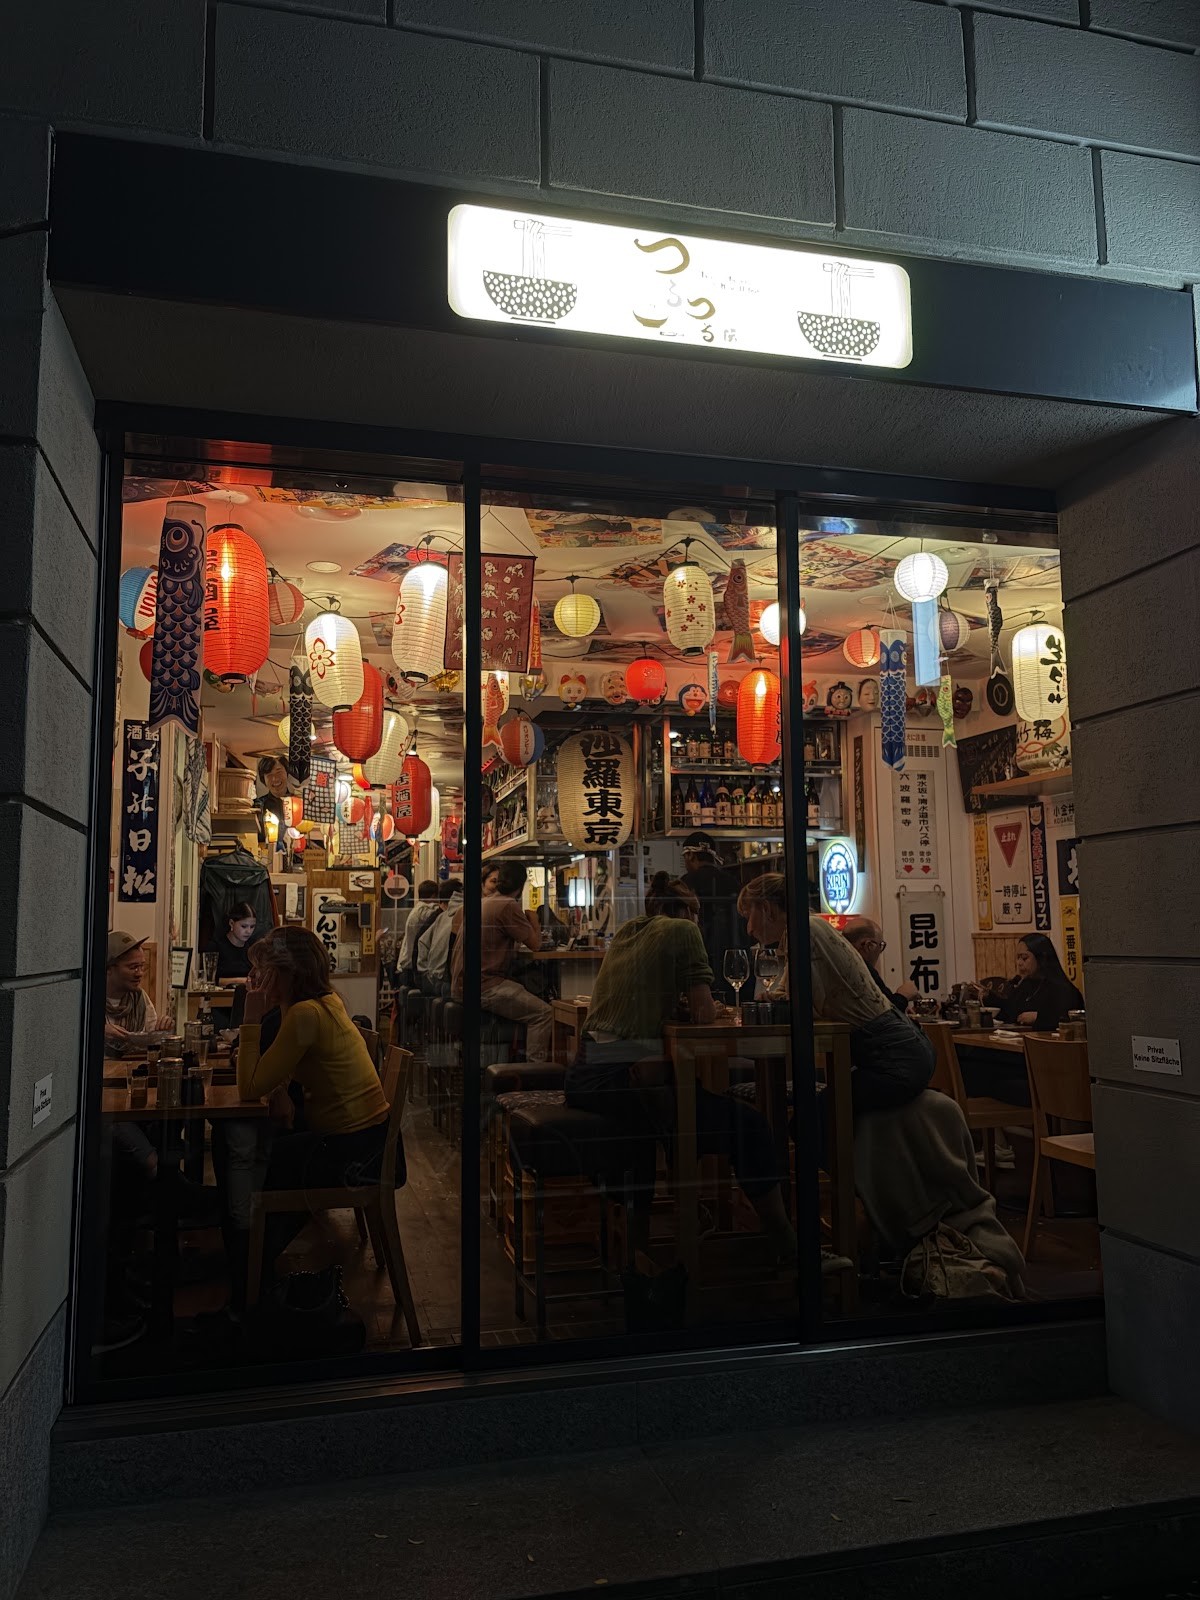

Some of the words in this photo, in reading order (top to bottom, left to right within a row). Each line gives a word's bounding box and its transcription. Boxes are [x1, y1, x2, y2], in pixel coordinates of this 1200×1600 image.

[395, 773, 413, 818] 居酒屋
[1001, 831, 1017, 843] 止まれ
[826, 874, 848, 889] KIRIN
[995, 884, 1028, 898] 一時停止
[909, 913, 940, 993] 昆布
[1147, 1045, 1165, 1055] Privat
[1134, 1053, 1150, 1063] Keine
